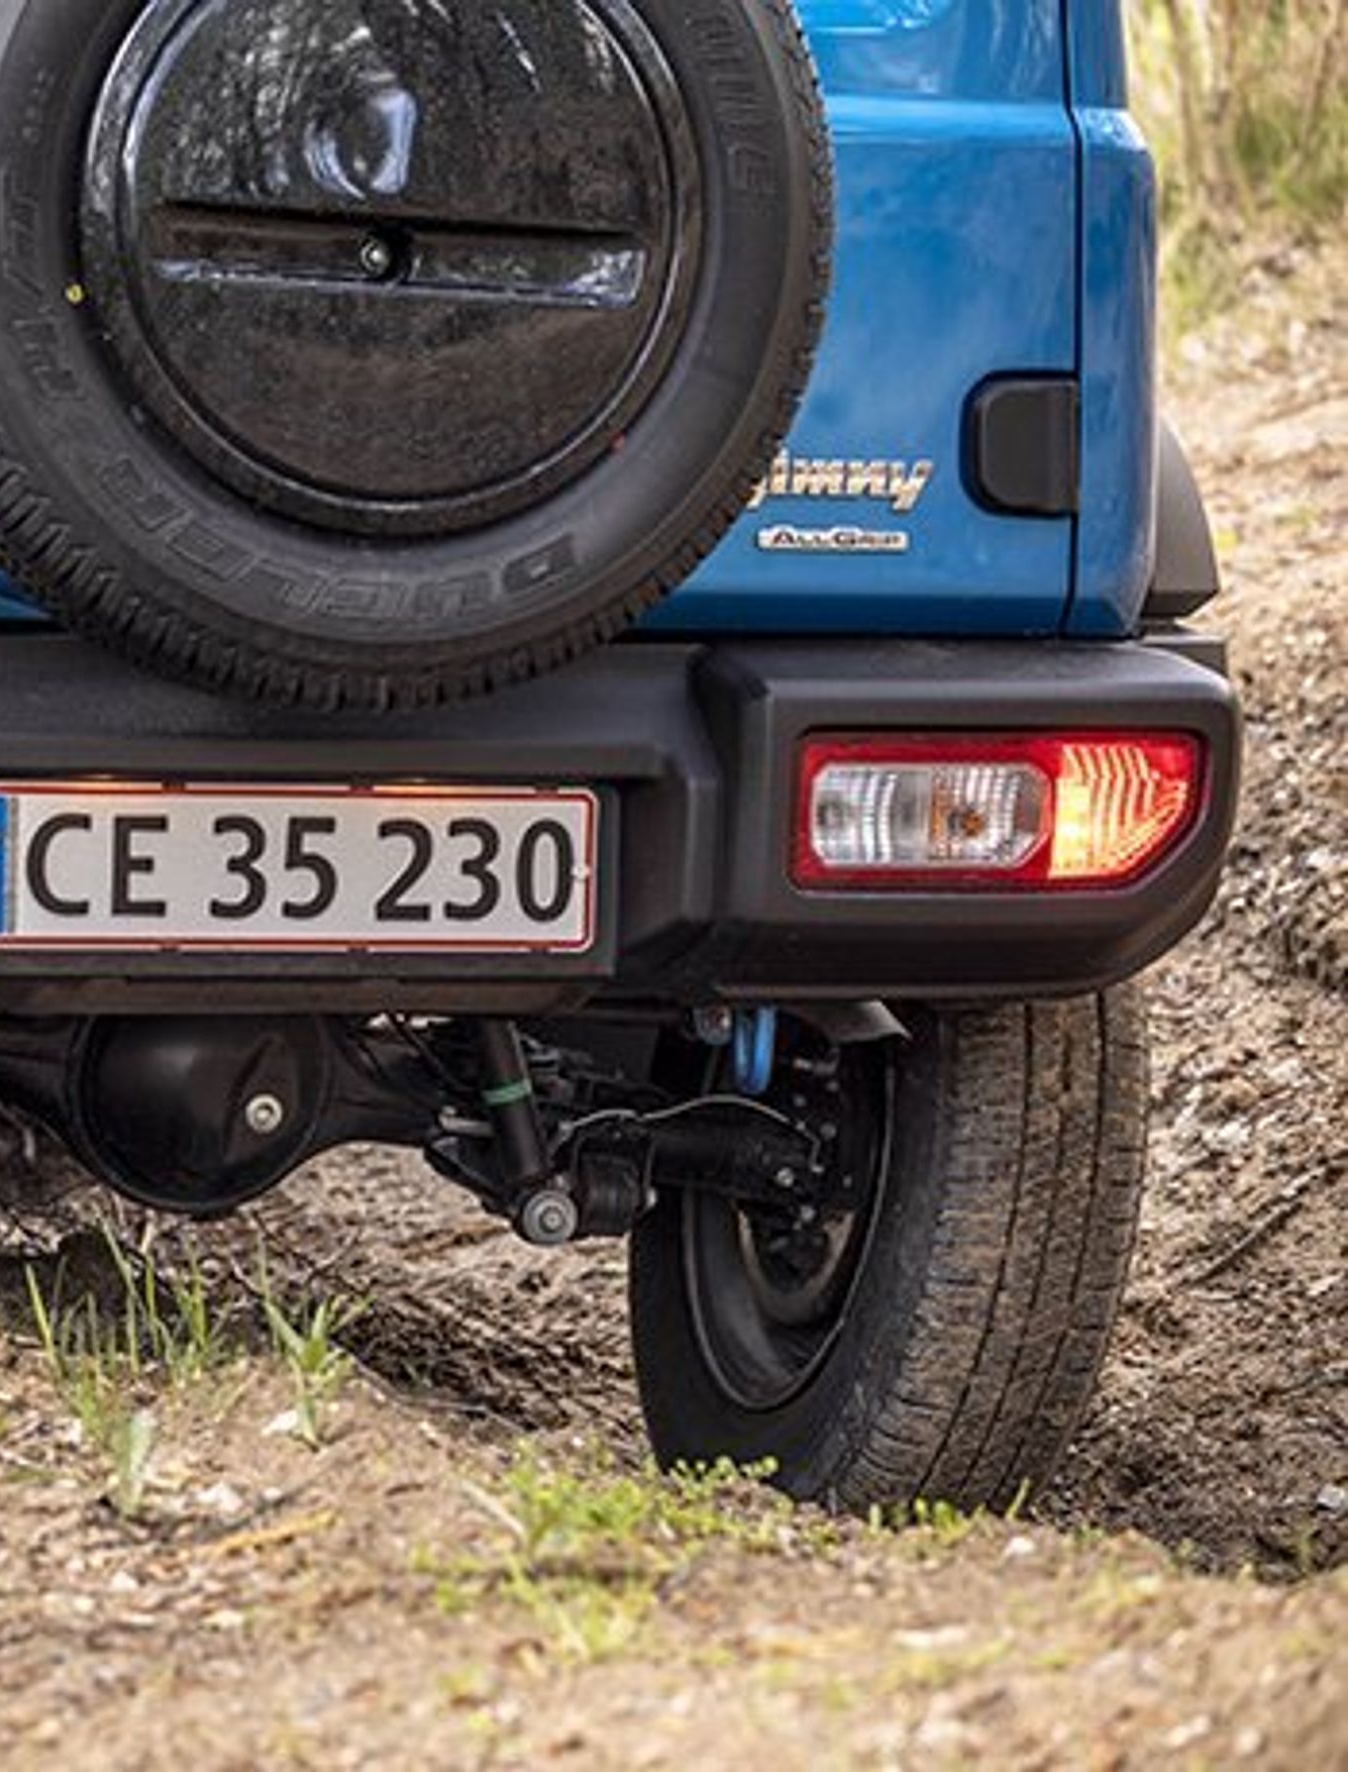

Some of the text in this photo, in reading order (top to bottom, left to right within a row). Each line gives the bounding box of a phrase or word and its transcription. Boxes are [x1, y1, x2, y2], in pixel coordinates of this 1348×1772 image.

[25, 814, 573, 923] CE 35 230
